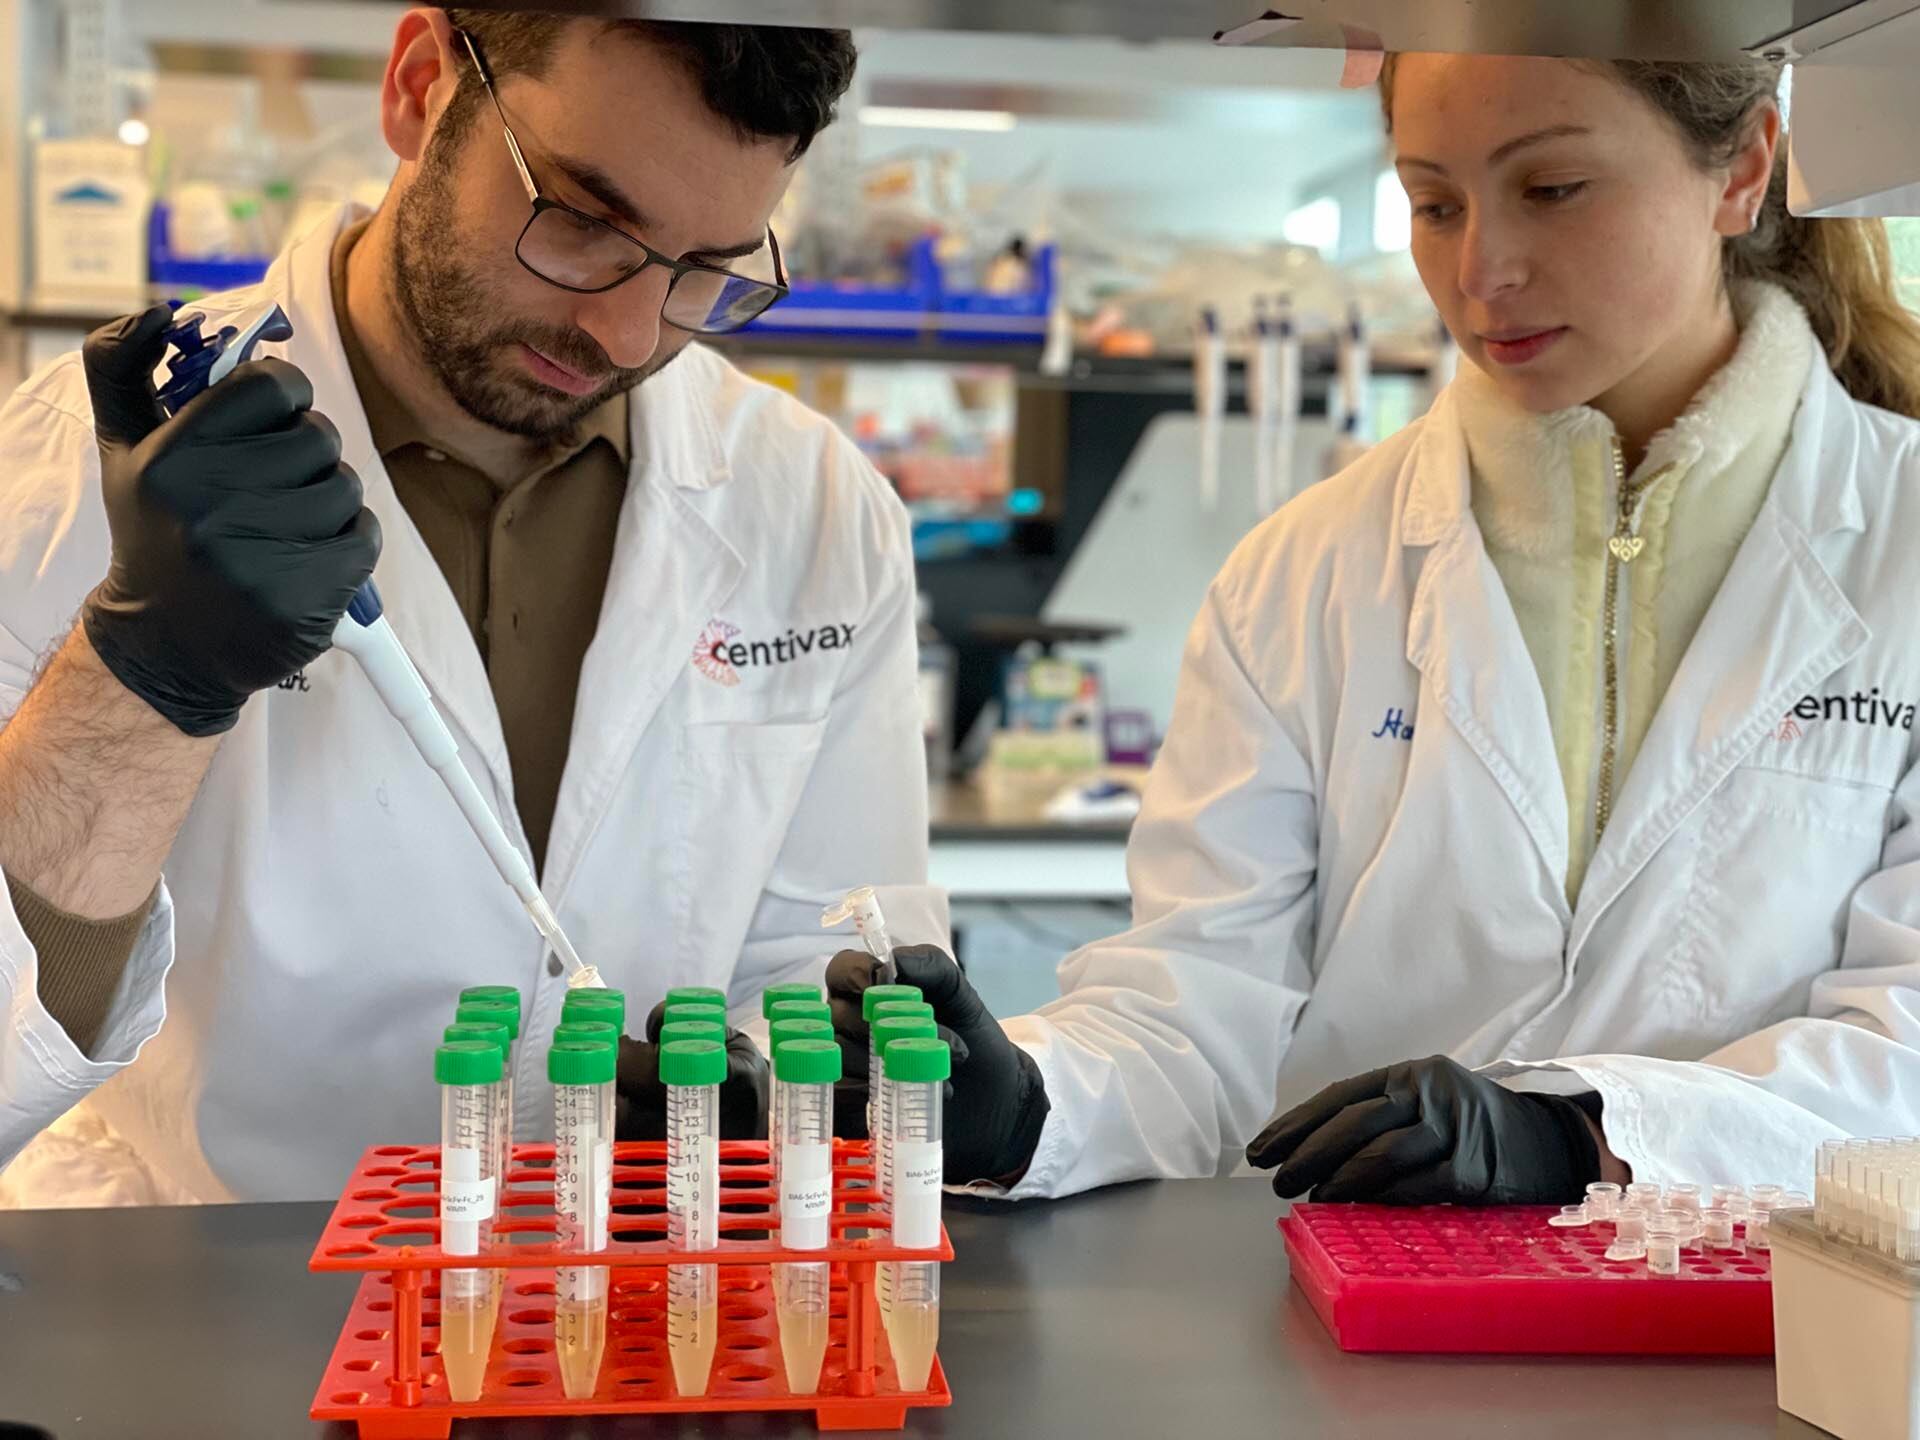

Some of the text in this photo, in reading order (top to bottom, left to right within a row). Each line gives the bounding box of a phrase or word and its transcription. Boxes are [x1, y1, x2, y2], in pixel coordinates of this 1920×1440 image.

[711, 624, 857, 668] centivax
[1784, 687, 1915, 730] entiva
[562, 1086, 596, 1096] 15mL
[563, 1099, 576, 1109] 14
[684, 1099, 698, 1109] 14
[564, 1117, 578, 1127] 13
[684, 1117, 700, 1127] 13
[564, 1135, 578, 1146] 12
[685, 1135, 700, 1146] 12
[564, 1154, 578, 1164] 11
[685, 1154, 700, 1164] 11
[564, 1173, 578, 1184] 10
[685, 1172, 700, 1183] 10
[569, 1192, 578, 1203] 9
[691, 1191, 700, 1202] 9
[569, 1212, 578, 1222] 8
[691, 1210, 700, 1221] 8
[569, 1232, 577, 1241] 7
[691, 1230, 699, 1241] 7
[569, 1272, 577, 1282] 5
[690, 1269, 699, 1280] 5
[568, 1292, 576, 1302] 4
[690, 1290, 698, 1300] 4
[568, 1314, 576, 1324] 3
[690, 1310, 698, 1321] 3
[568, 1335, 576, 1346] 2
[690, 1332, 698, 1343] 2
